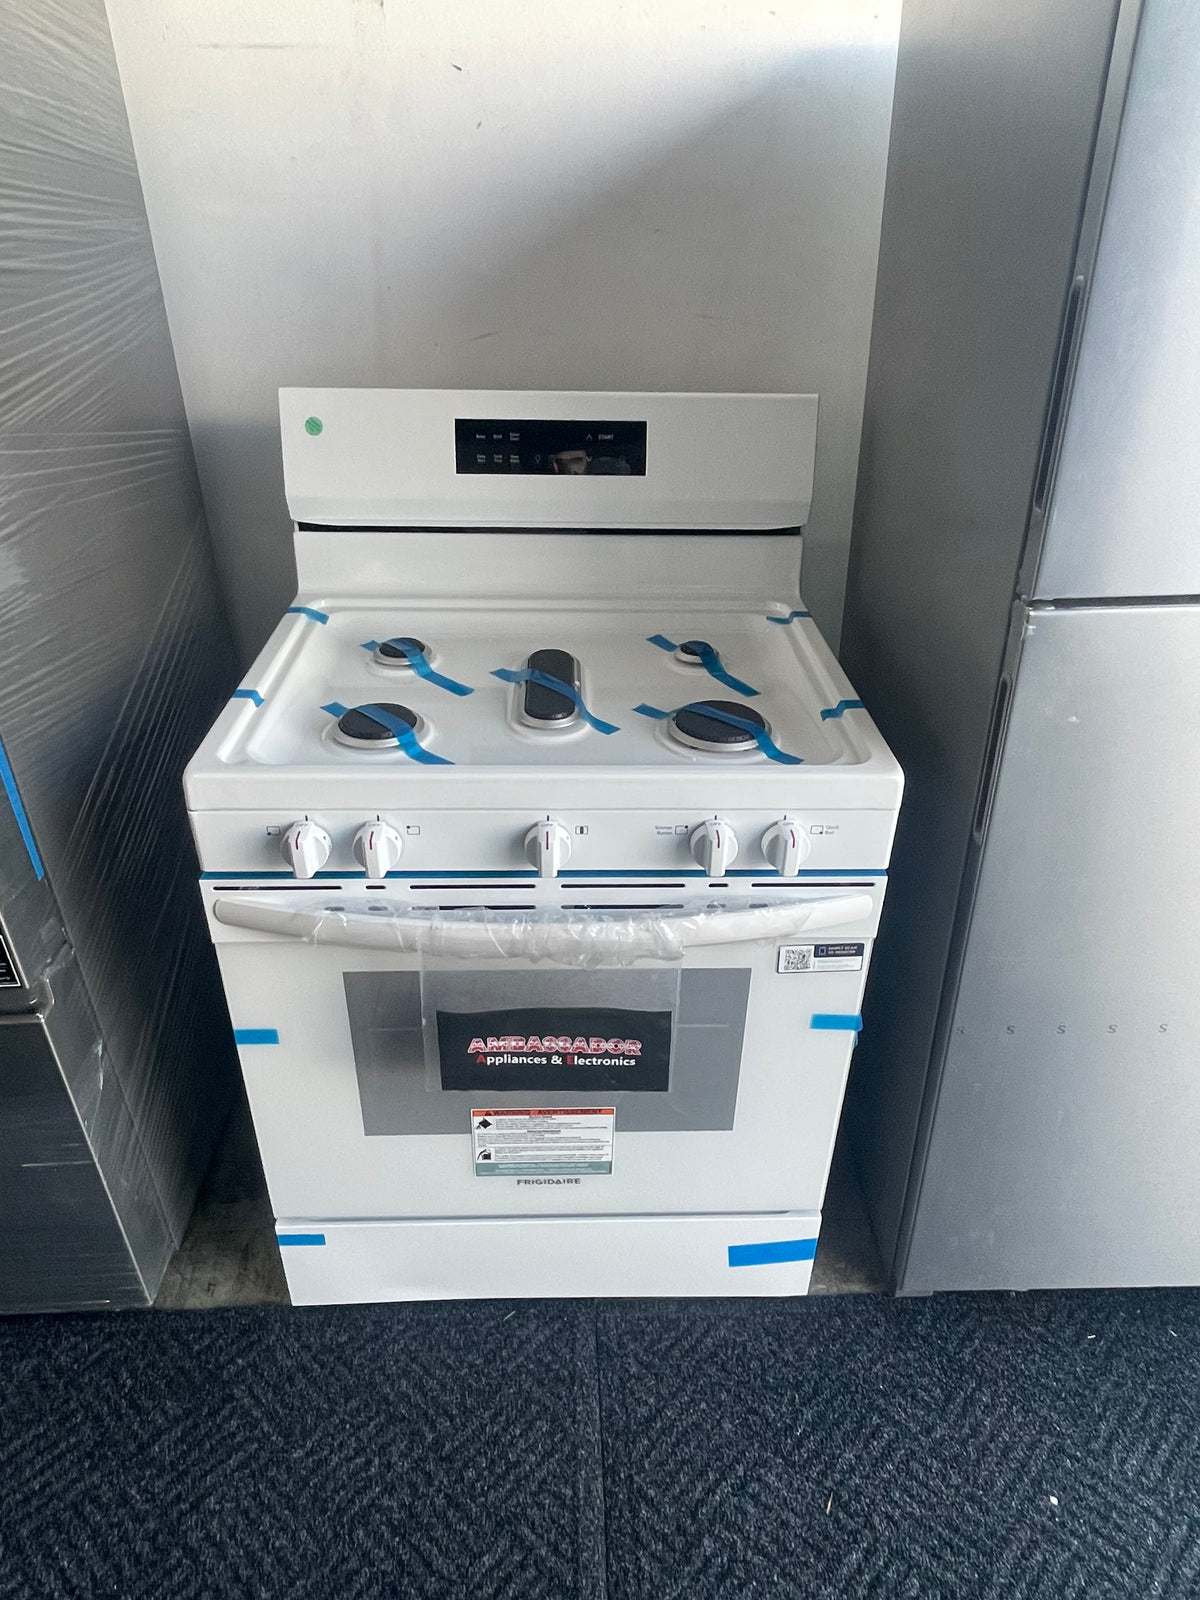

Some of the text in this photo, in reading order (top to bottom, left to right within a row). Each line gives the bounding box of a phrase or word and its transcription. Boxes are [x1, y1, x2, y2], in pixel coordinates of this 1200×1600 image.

[467, 1035, 642, 1056] AMBASSADOR
[476, 1054, 636, 1066] Appliances & Electronics
[516, 1178, 581, 1186] FRIGIDAIRE
